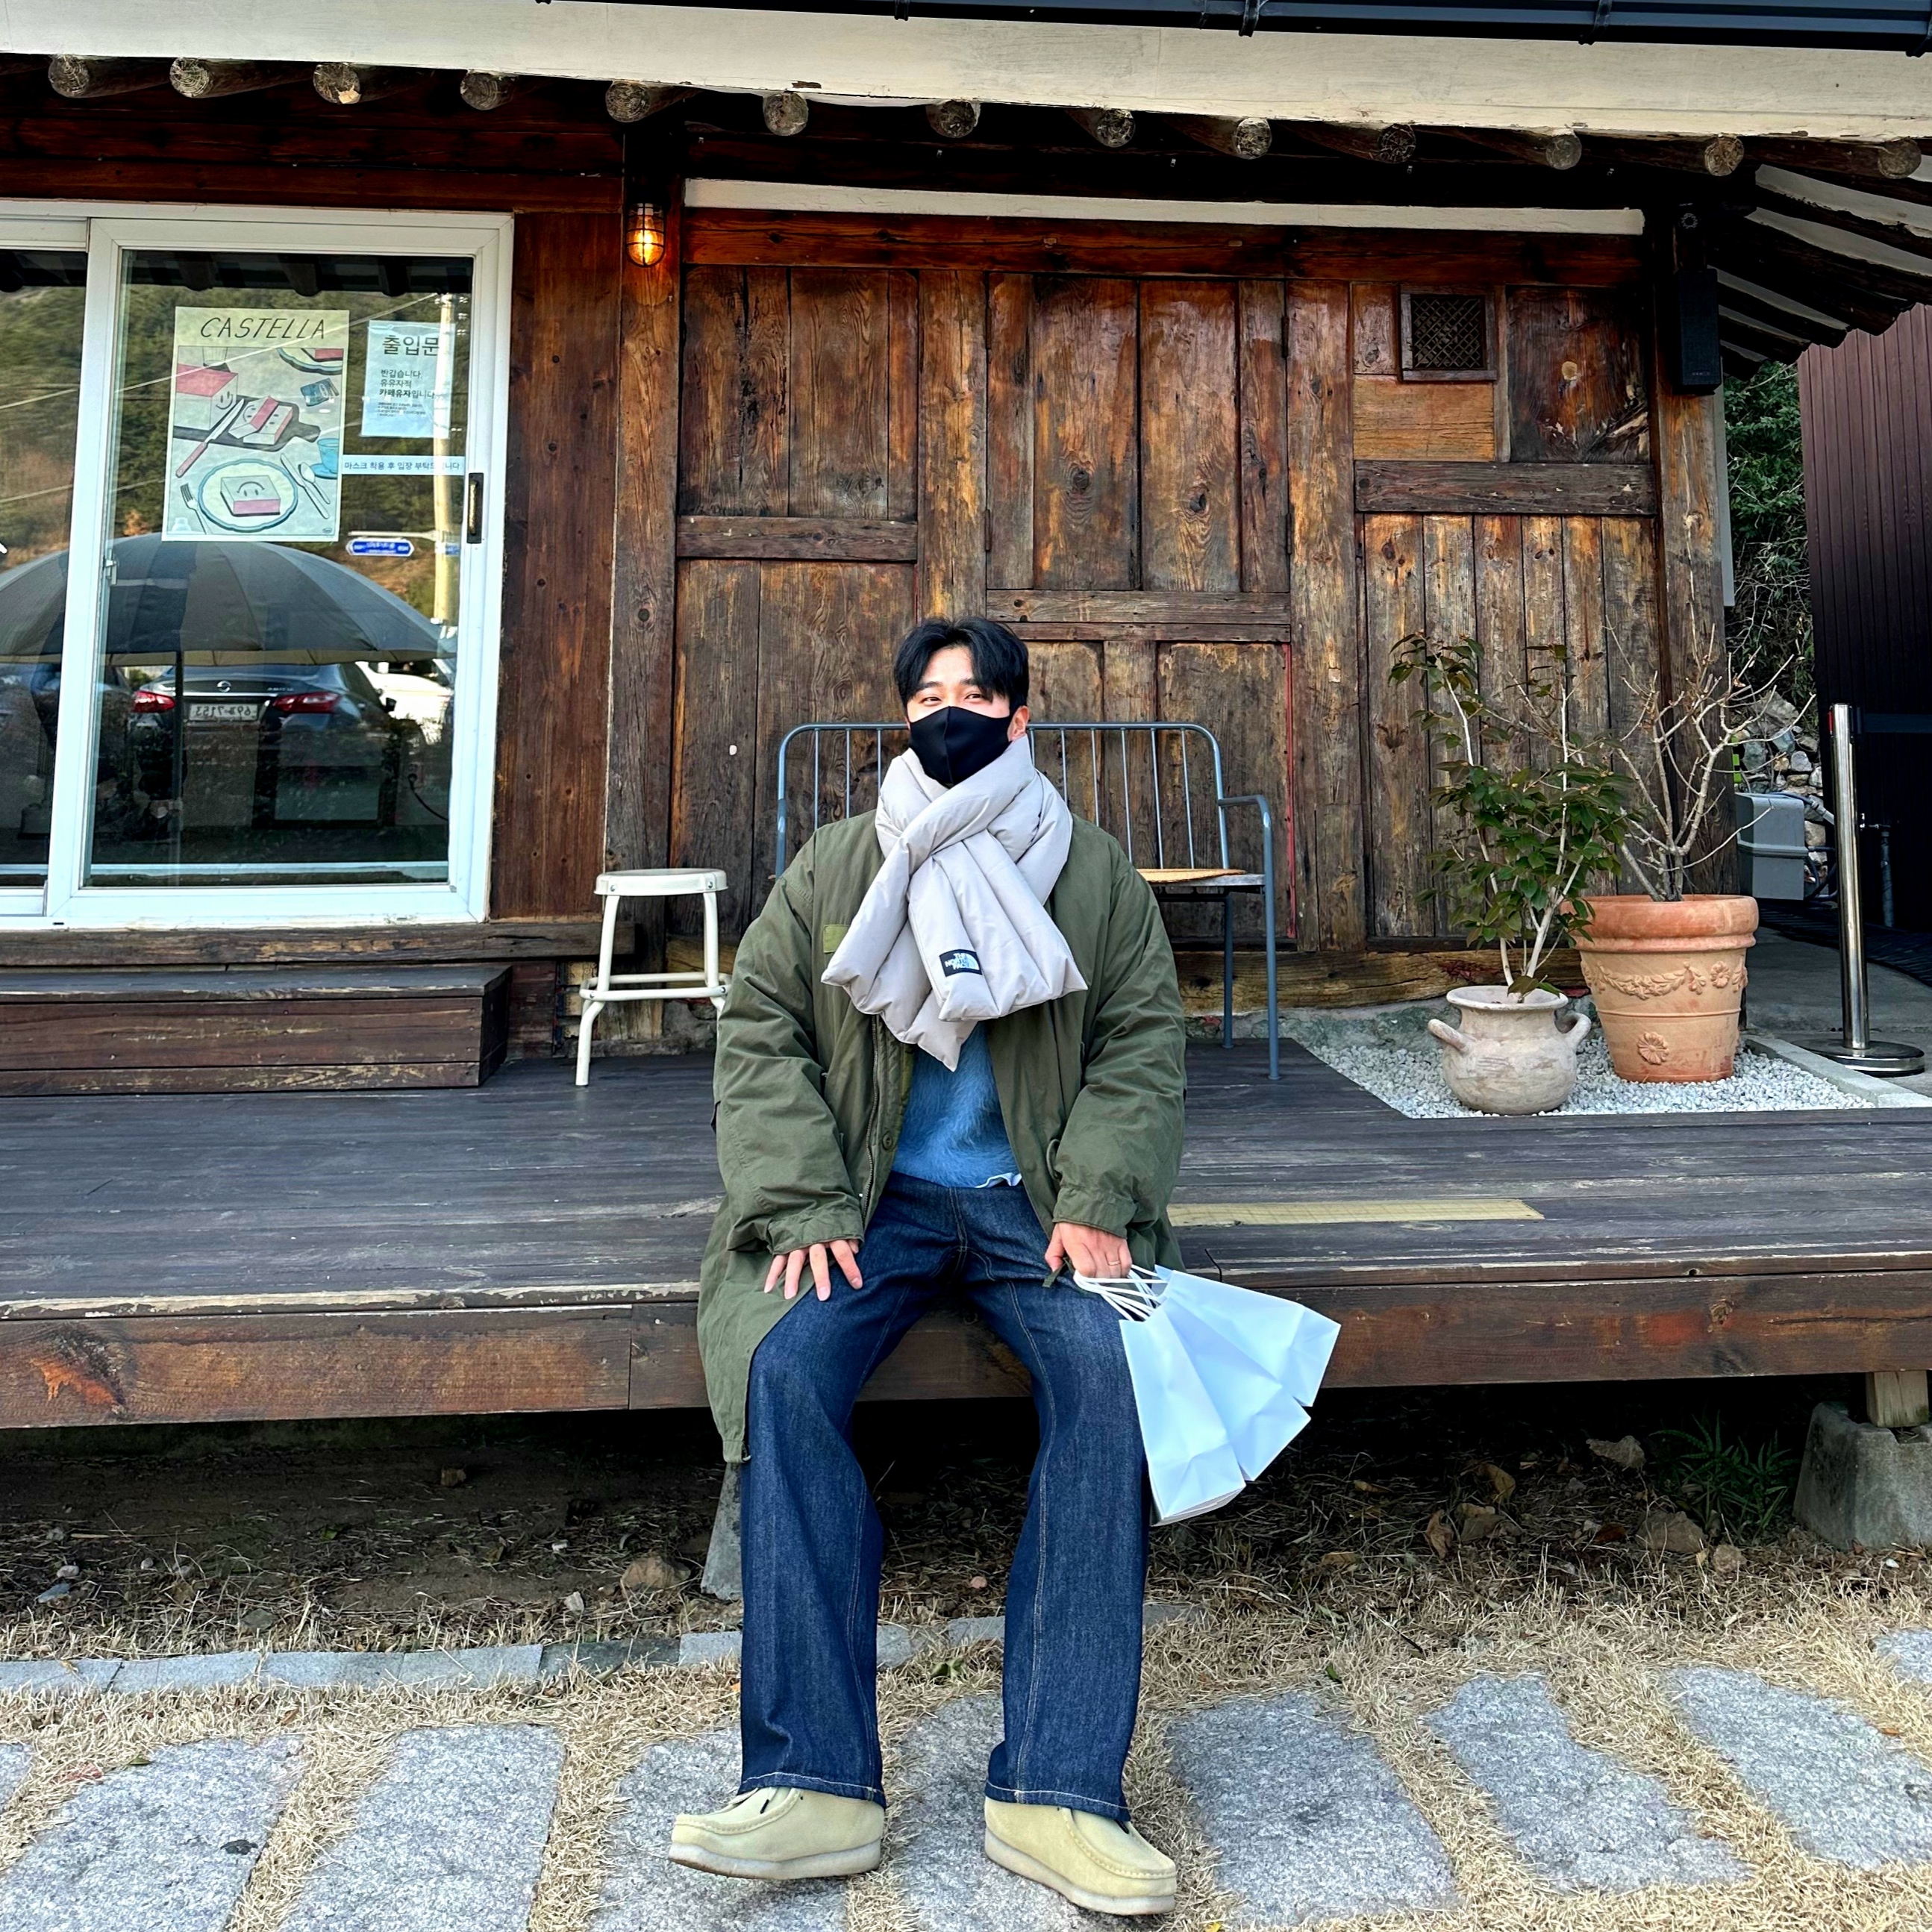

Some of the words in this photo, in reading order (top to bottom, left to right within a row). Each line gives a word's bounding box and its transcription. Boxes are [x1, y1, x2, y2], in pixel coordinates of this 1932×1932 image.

[200, 317, 325, 340] CASTELLA
[382, 335, 440, 356] 출입문
[381, 379, 412, 389] 유유자적
[370, 462, 385, 470] 착용
[397, 462, 413, 470] 입장
[415, 462, 460, 470] 부탁드니다
